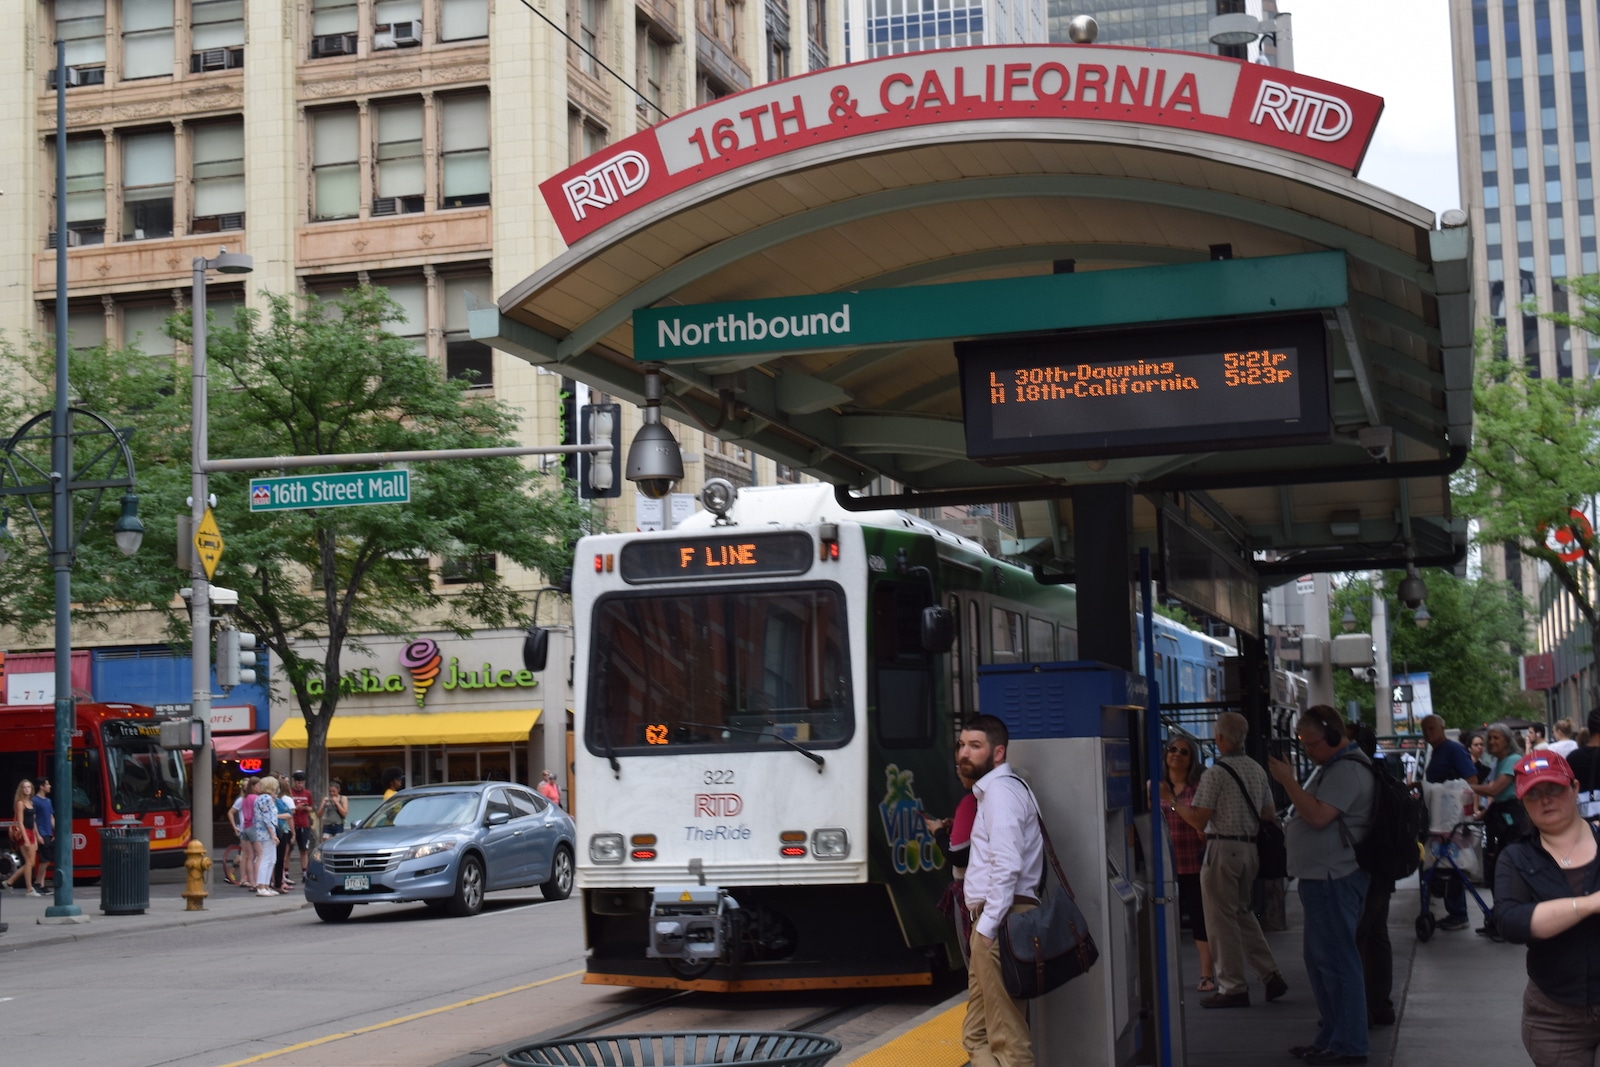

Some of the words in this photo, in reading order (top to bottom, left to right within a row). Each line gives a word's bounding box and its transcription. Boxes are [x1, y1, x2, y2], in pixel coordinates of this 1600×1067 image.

[687, 95, 808, 164] 16TH
[827, 84, 862, 125] &
[879, 62, 1201, 115] CALIFORNIA
[1248, 78, 1354, 143] RTD
[561, 150, 650, 222] RTD
[657, 304, 851, 348] Northbound
[989, 371, 1004, 388] L
[1014, 360, 1175, 386] 30th-Downing
[991, 387, 1006, 405] H
[1015, 373, 1199, 403] 18th-California
[272, 481, 307, 504] 16th
[312, 478, 364, 502] Street
[369, 475, 406, 498] Mall
[679, 547, 695, 568] F
[705, 543, 757, 567] LINE
[645, 724, 669, 745] 62
[703, 769, 735, 786] 322
[694, 793, 744, 818] RTD
[879, 799, 930, 848] VITA
[892, 838, 946, 875] COCO
